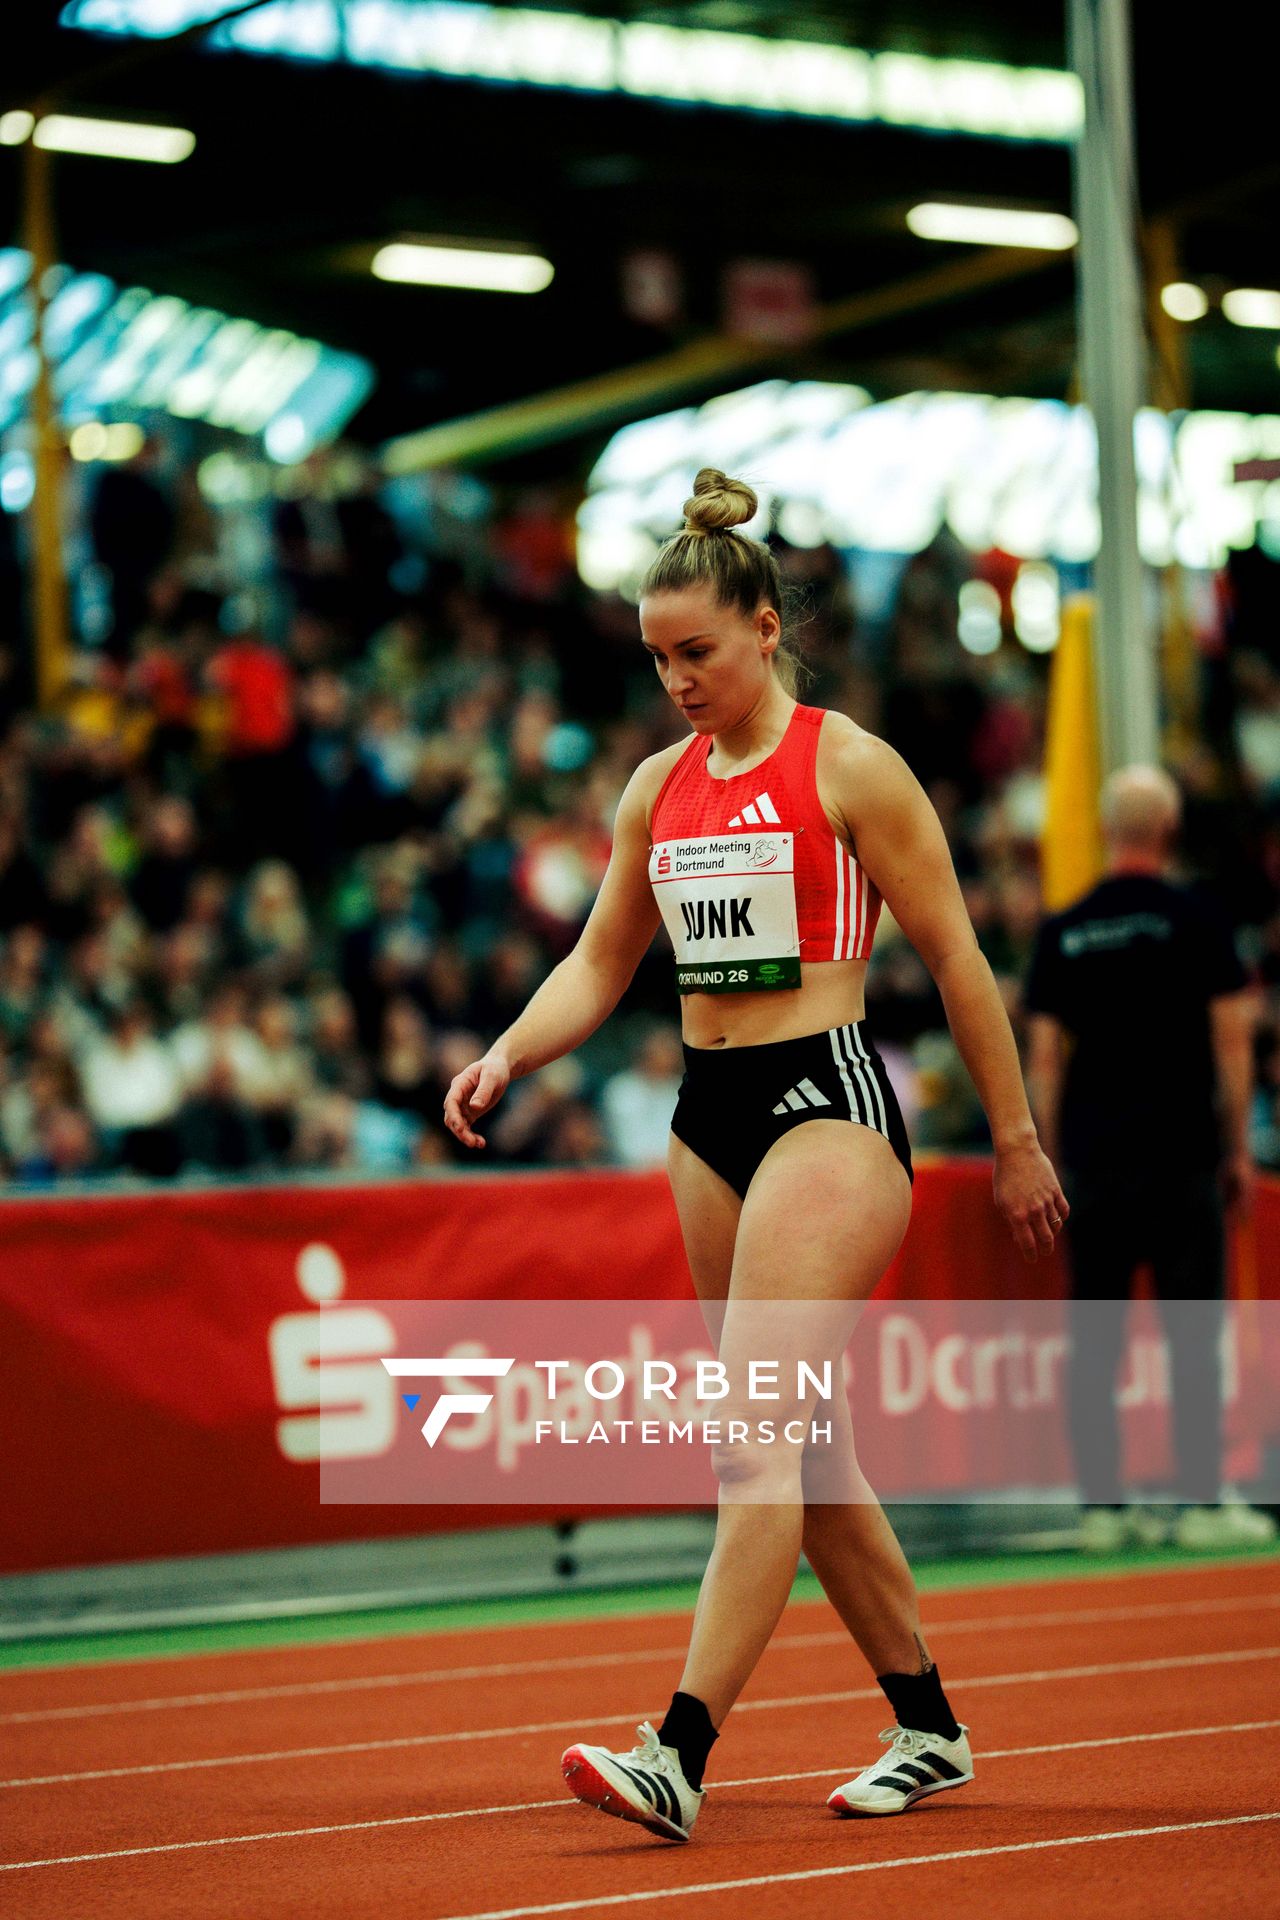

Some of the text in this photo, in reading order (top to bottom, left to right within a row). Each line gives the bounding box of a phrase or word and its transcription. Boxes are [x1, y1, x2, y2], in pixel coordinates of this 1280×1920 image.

[676, 841, 751, 857] Indoor Meeting
[675, 858, 725, 872] Dortmund
[680, 897, 755, 942] JUNK
[678, 971, 724, 985] DORTMUND
[727, 969, 749, 983] 26
